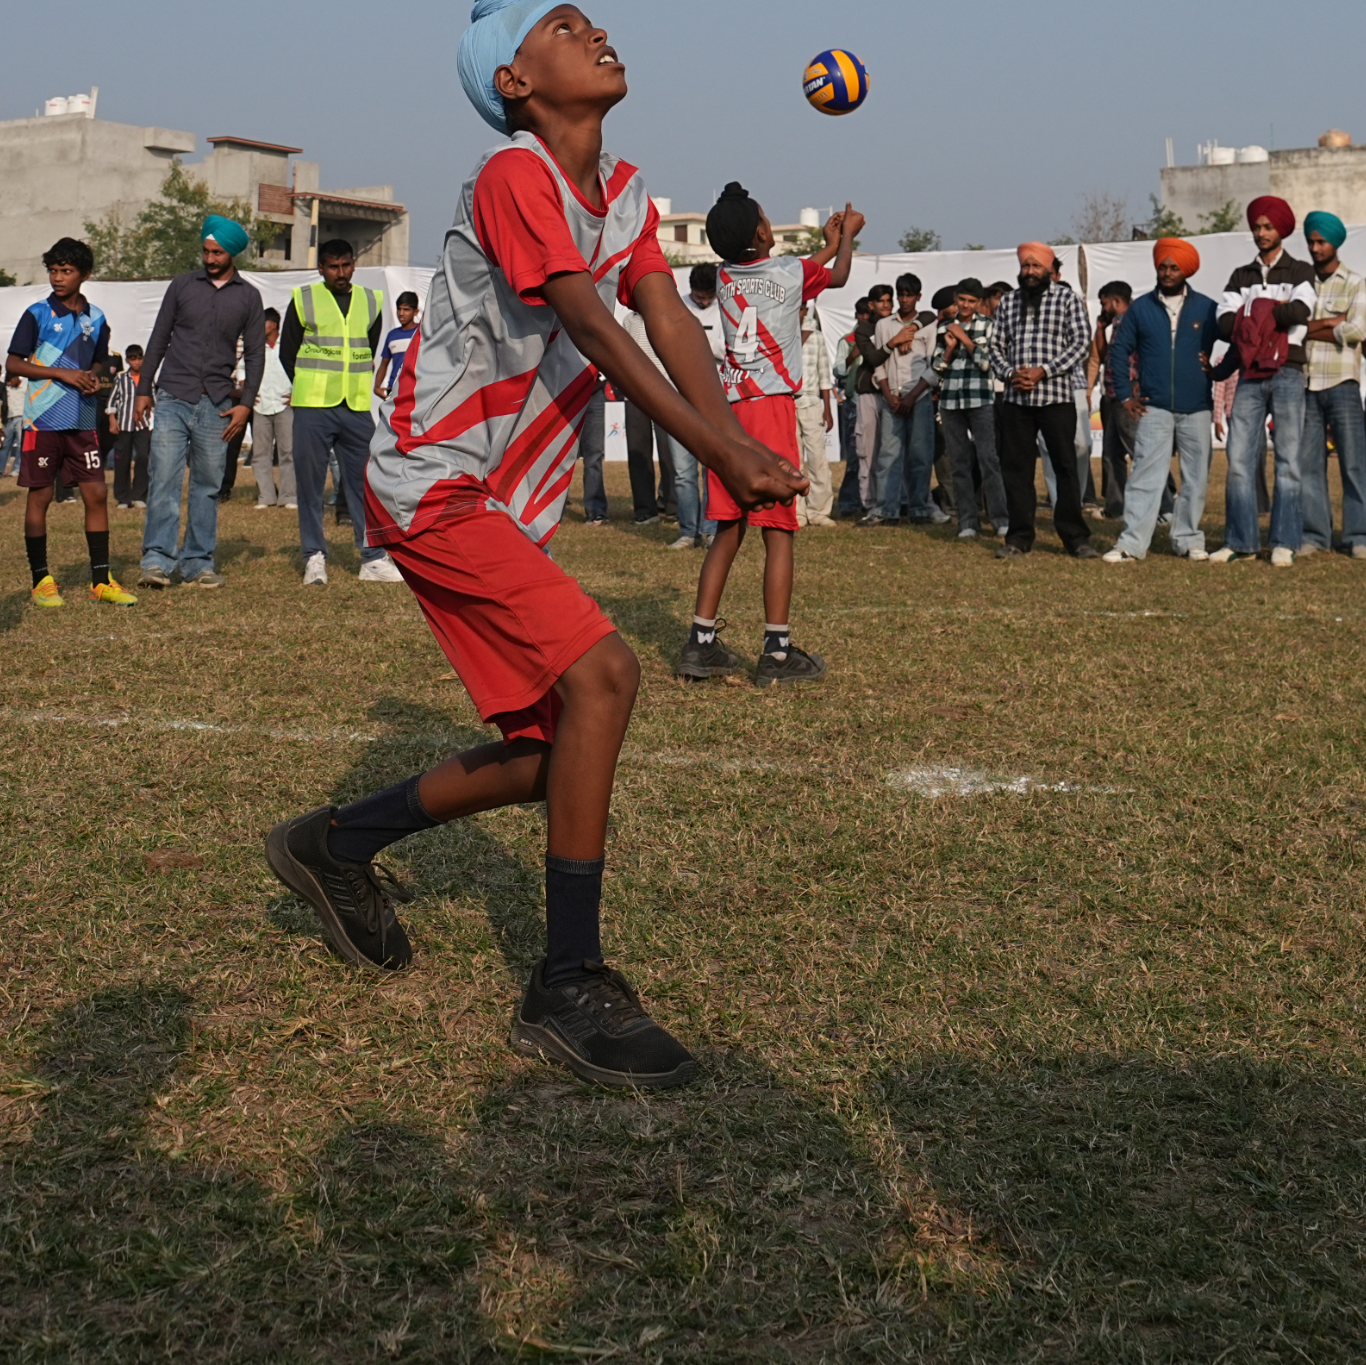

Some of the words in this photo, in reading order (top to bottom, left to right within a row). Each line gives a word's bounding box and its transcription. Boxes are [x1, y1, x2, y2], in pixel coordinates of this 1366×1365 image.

[736, 278, 764, 295] SPORTS
[765, 280, 786, 303] CLUB
[733, 306, 760, 363] 4
[84, 450, 101, 469] 15
